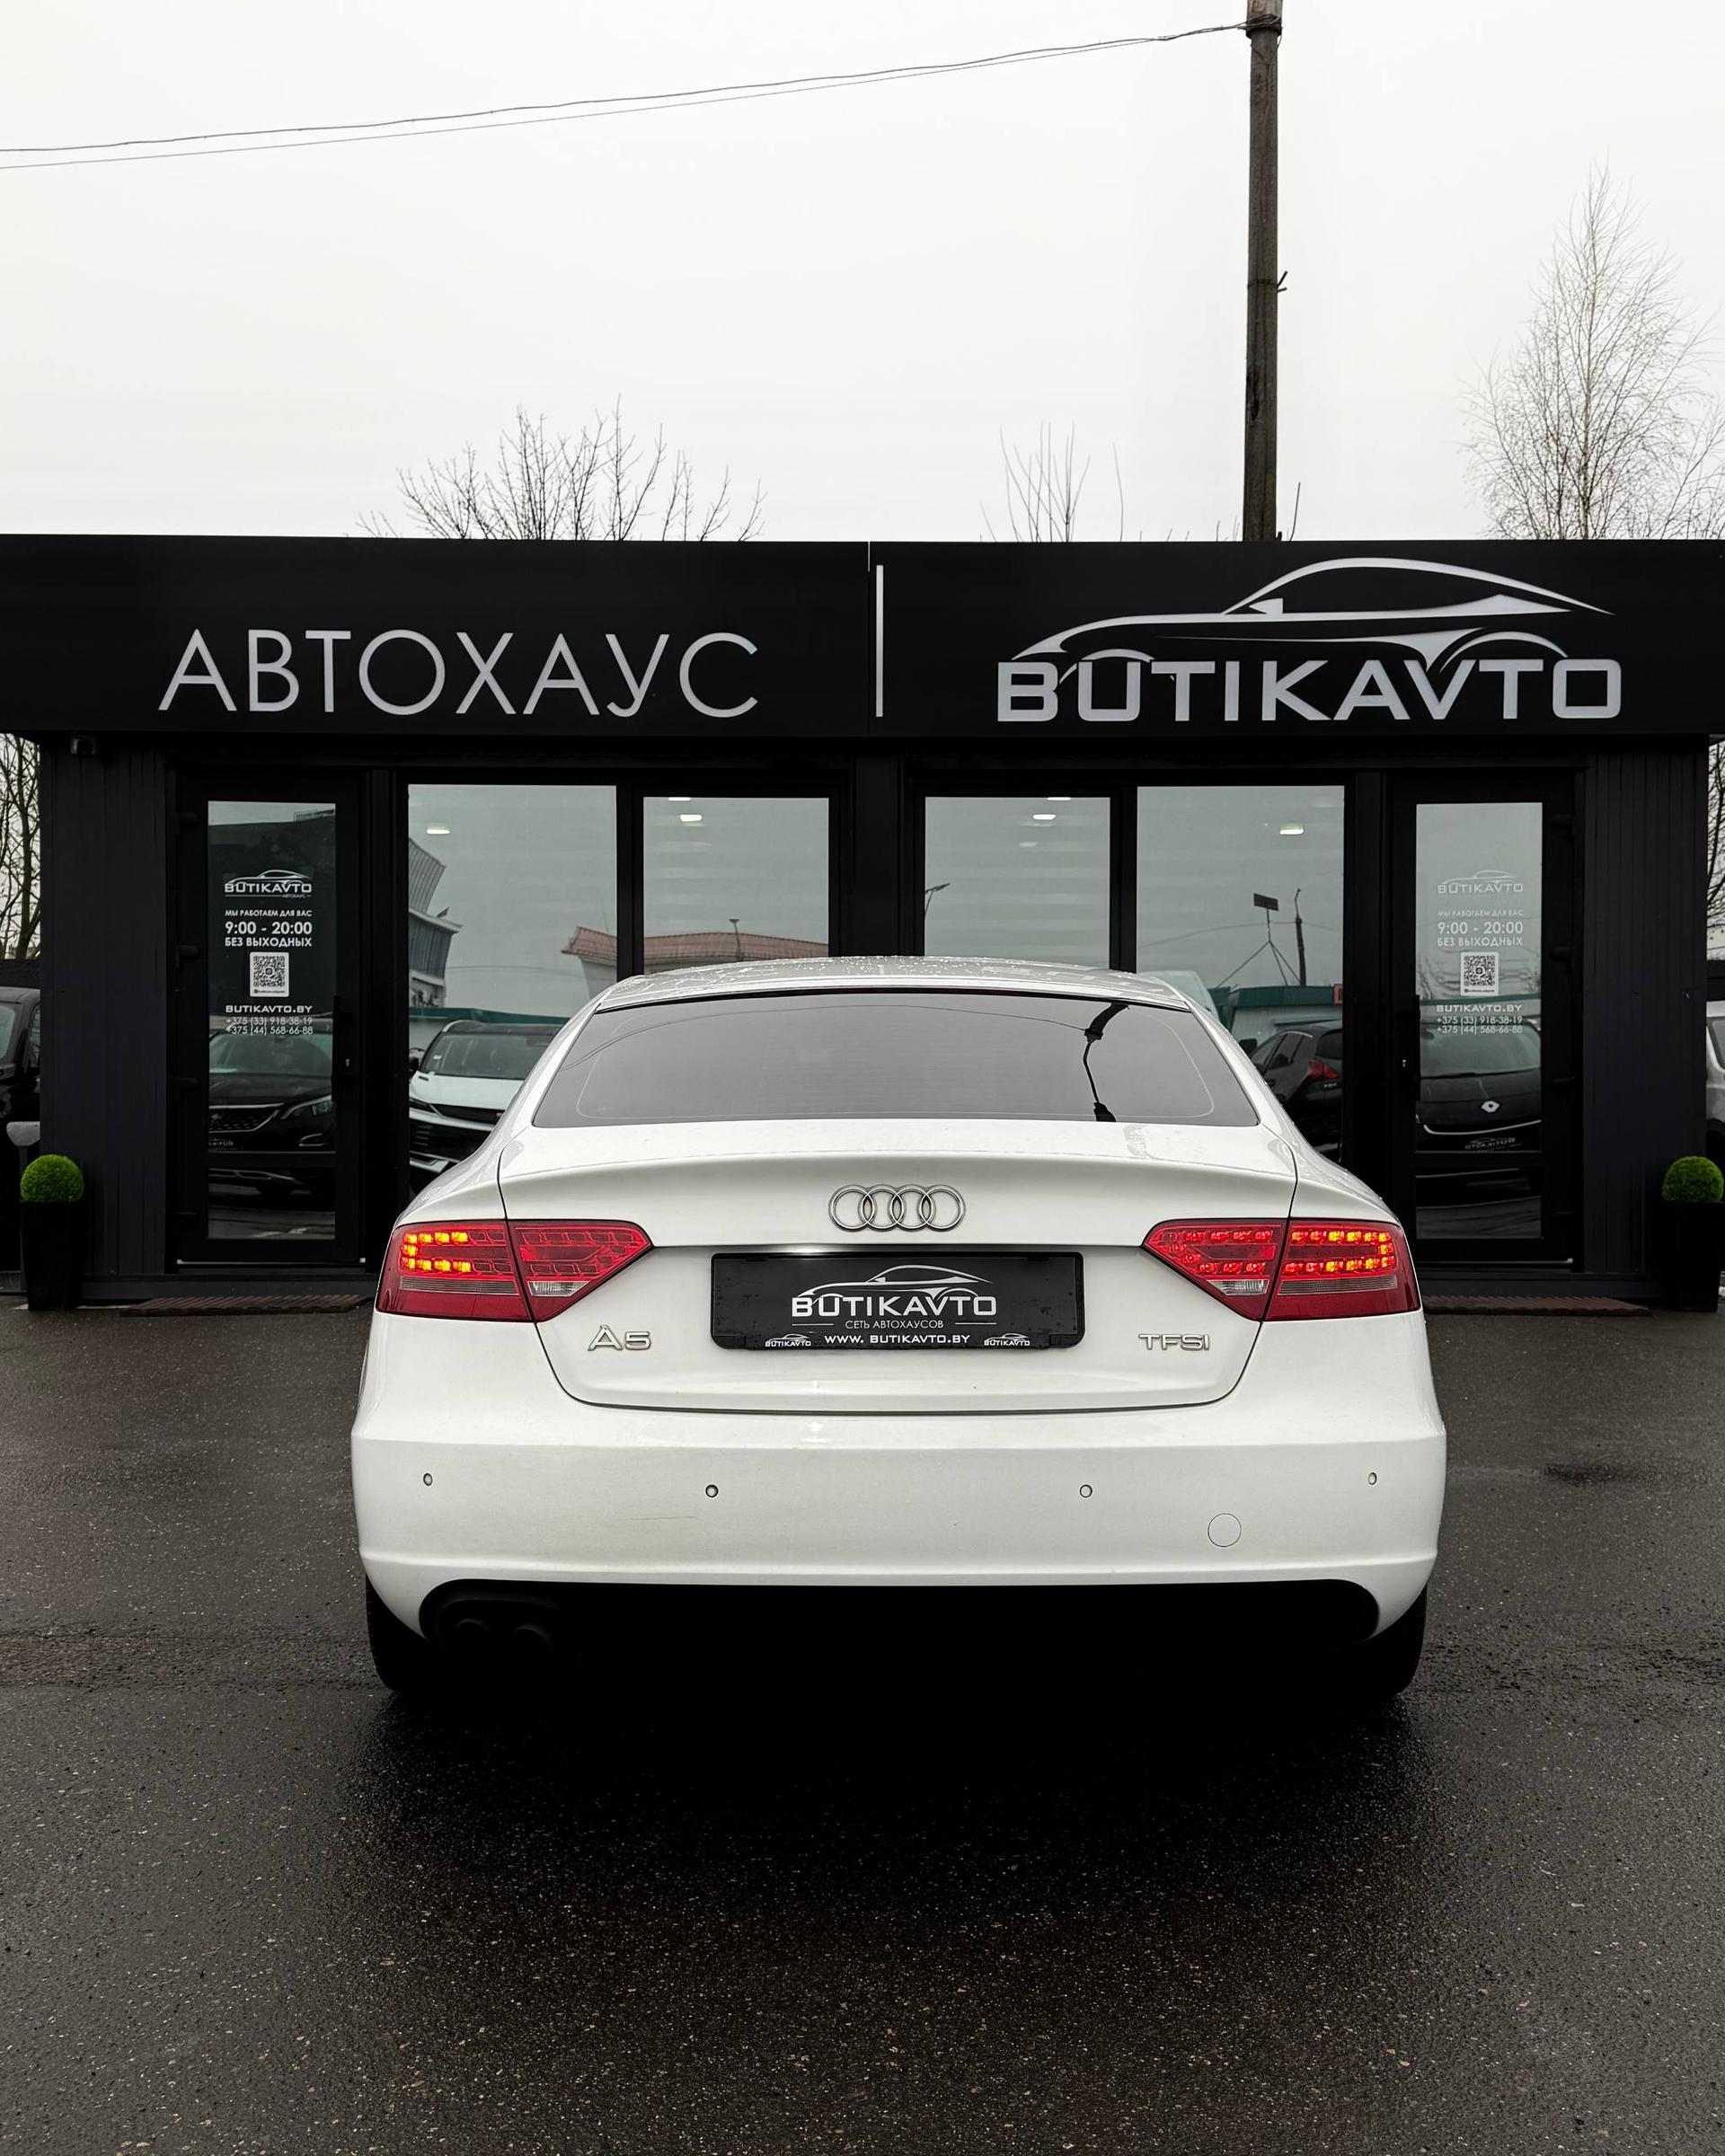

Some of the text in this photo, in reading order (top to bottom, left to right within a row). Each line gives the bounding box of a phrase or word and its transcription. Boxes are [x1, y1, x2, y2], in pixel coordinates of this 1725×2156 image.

[158, 629, 758, 718] АВТОХАУС
[997, 658, 1622, 721] BUTIKAVTO
[225, 883, 312, 893] BUTIKAVTO
[1438, 883, 1523, 893] BUTIKAVTO
[225, 922, 256, 934] 9:00
[271, 922, 312, 934] 20:00
[1438, 922, 1468, 934] 9:00
[1483, 922, 1523, 934] 20:00
[225, 937, 312, 948] БЕЗ ВЫХОДНЫХ
[1438, 937, 1523, 947] БЕЗ ВЫХОДНЫХ
[226, 1005, 312, 1013] BUTIKAVTO.BY
[1437, 1004, 1522, 1012] BUTIKAVTO.BY
[226, 1016, 312, 1027] +375 (33) 918-38-19
[1437, 1016, 1522, 1026] +375 (33) 918-38-19
[226, 1026, 313, 1036] +375 (44) 568-66-88
[1461, 1026, 1477, 1035] (44)
[1480, 1025, 1523, 1034] 568-66-88
[792, 1296, 996, 1317] BUTIKAVTO
[845, 1320, 944, 1329] СЕТЬ АВТОХАУСОВ
[588, 1324, 651, 1351] A5
[870, 1334, 970, 1344] BUTIKAVTO.BY
[1138, 1334, 1209, 1351] TFSI
